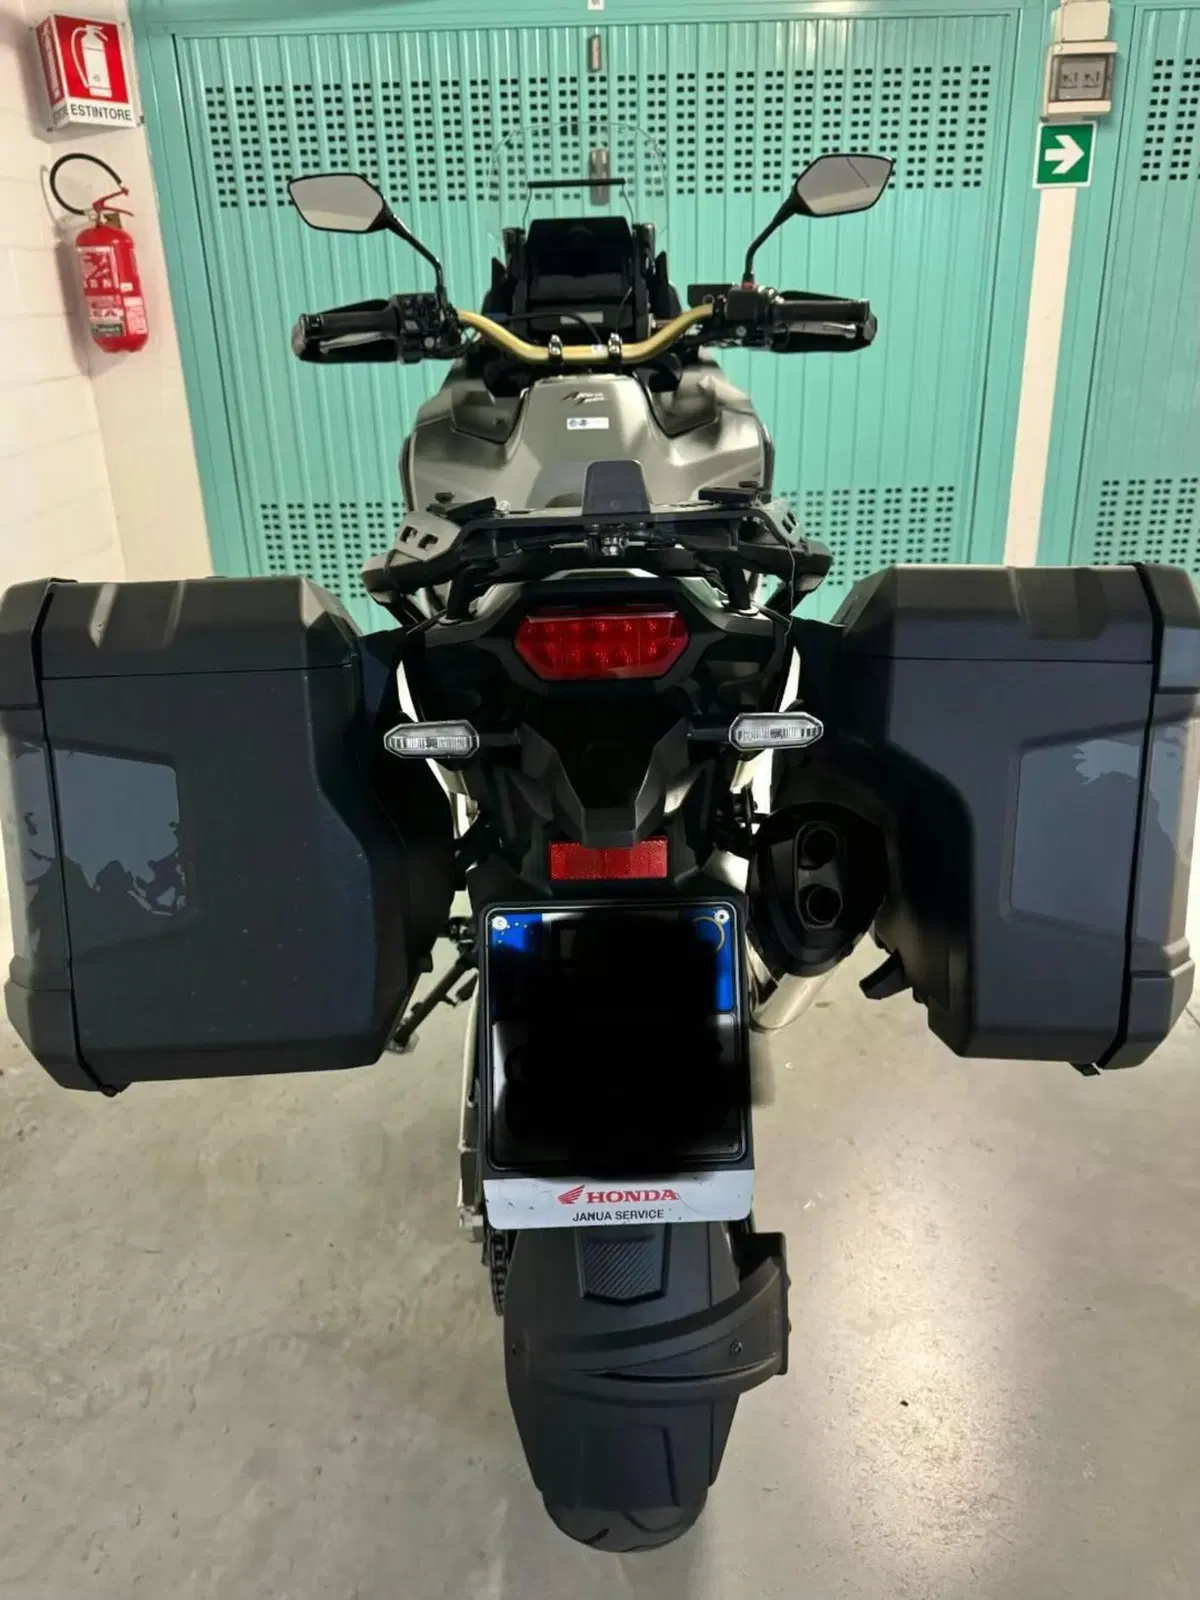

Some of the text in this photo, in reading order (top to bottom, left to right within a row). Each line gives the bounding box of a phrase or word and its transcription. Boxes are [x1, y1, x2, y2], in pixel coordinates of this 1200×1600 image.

[70, 104, 132, 120] ESTINTORE
[586, 1189, 679, 1203] HONDA
[572, 1209, 664, 1222] JANUA SERVICE
